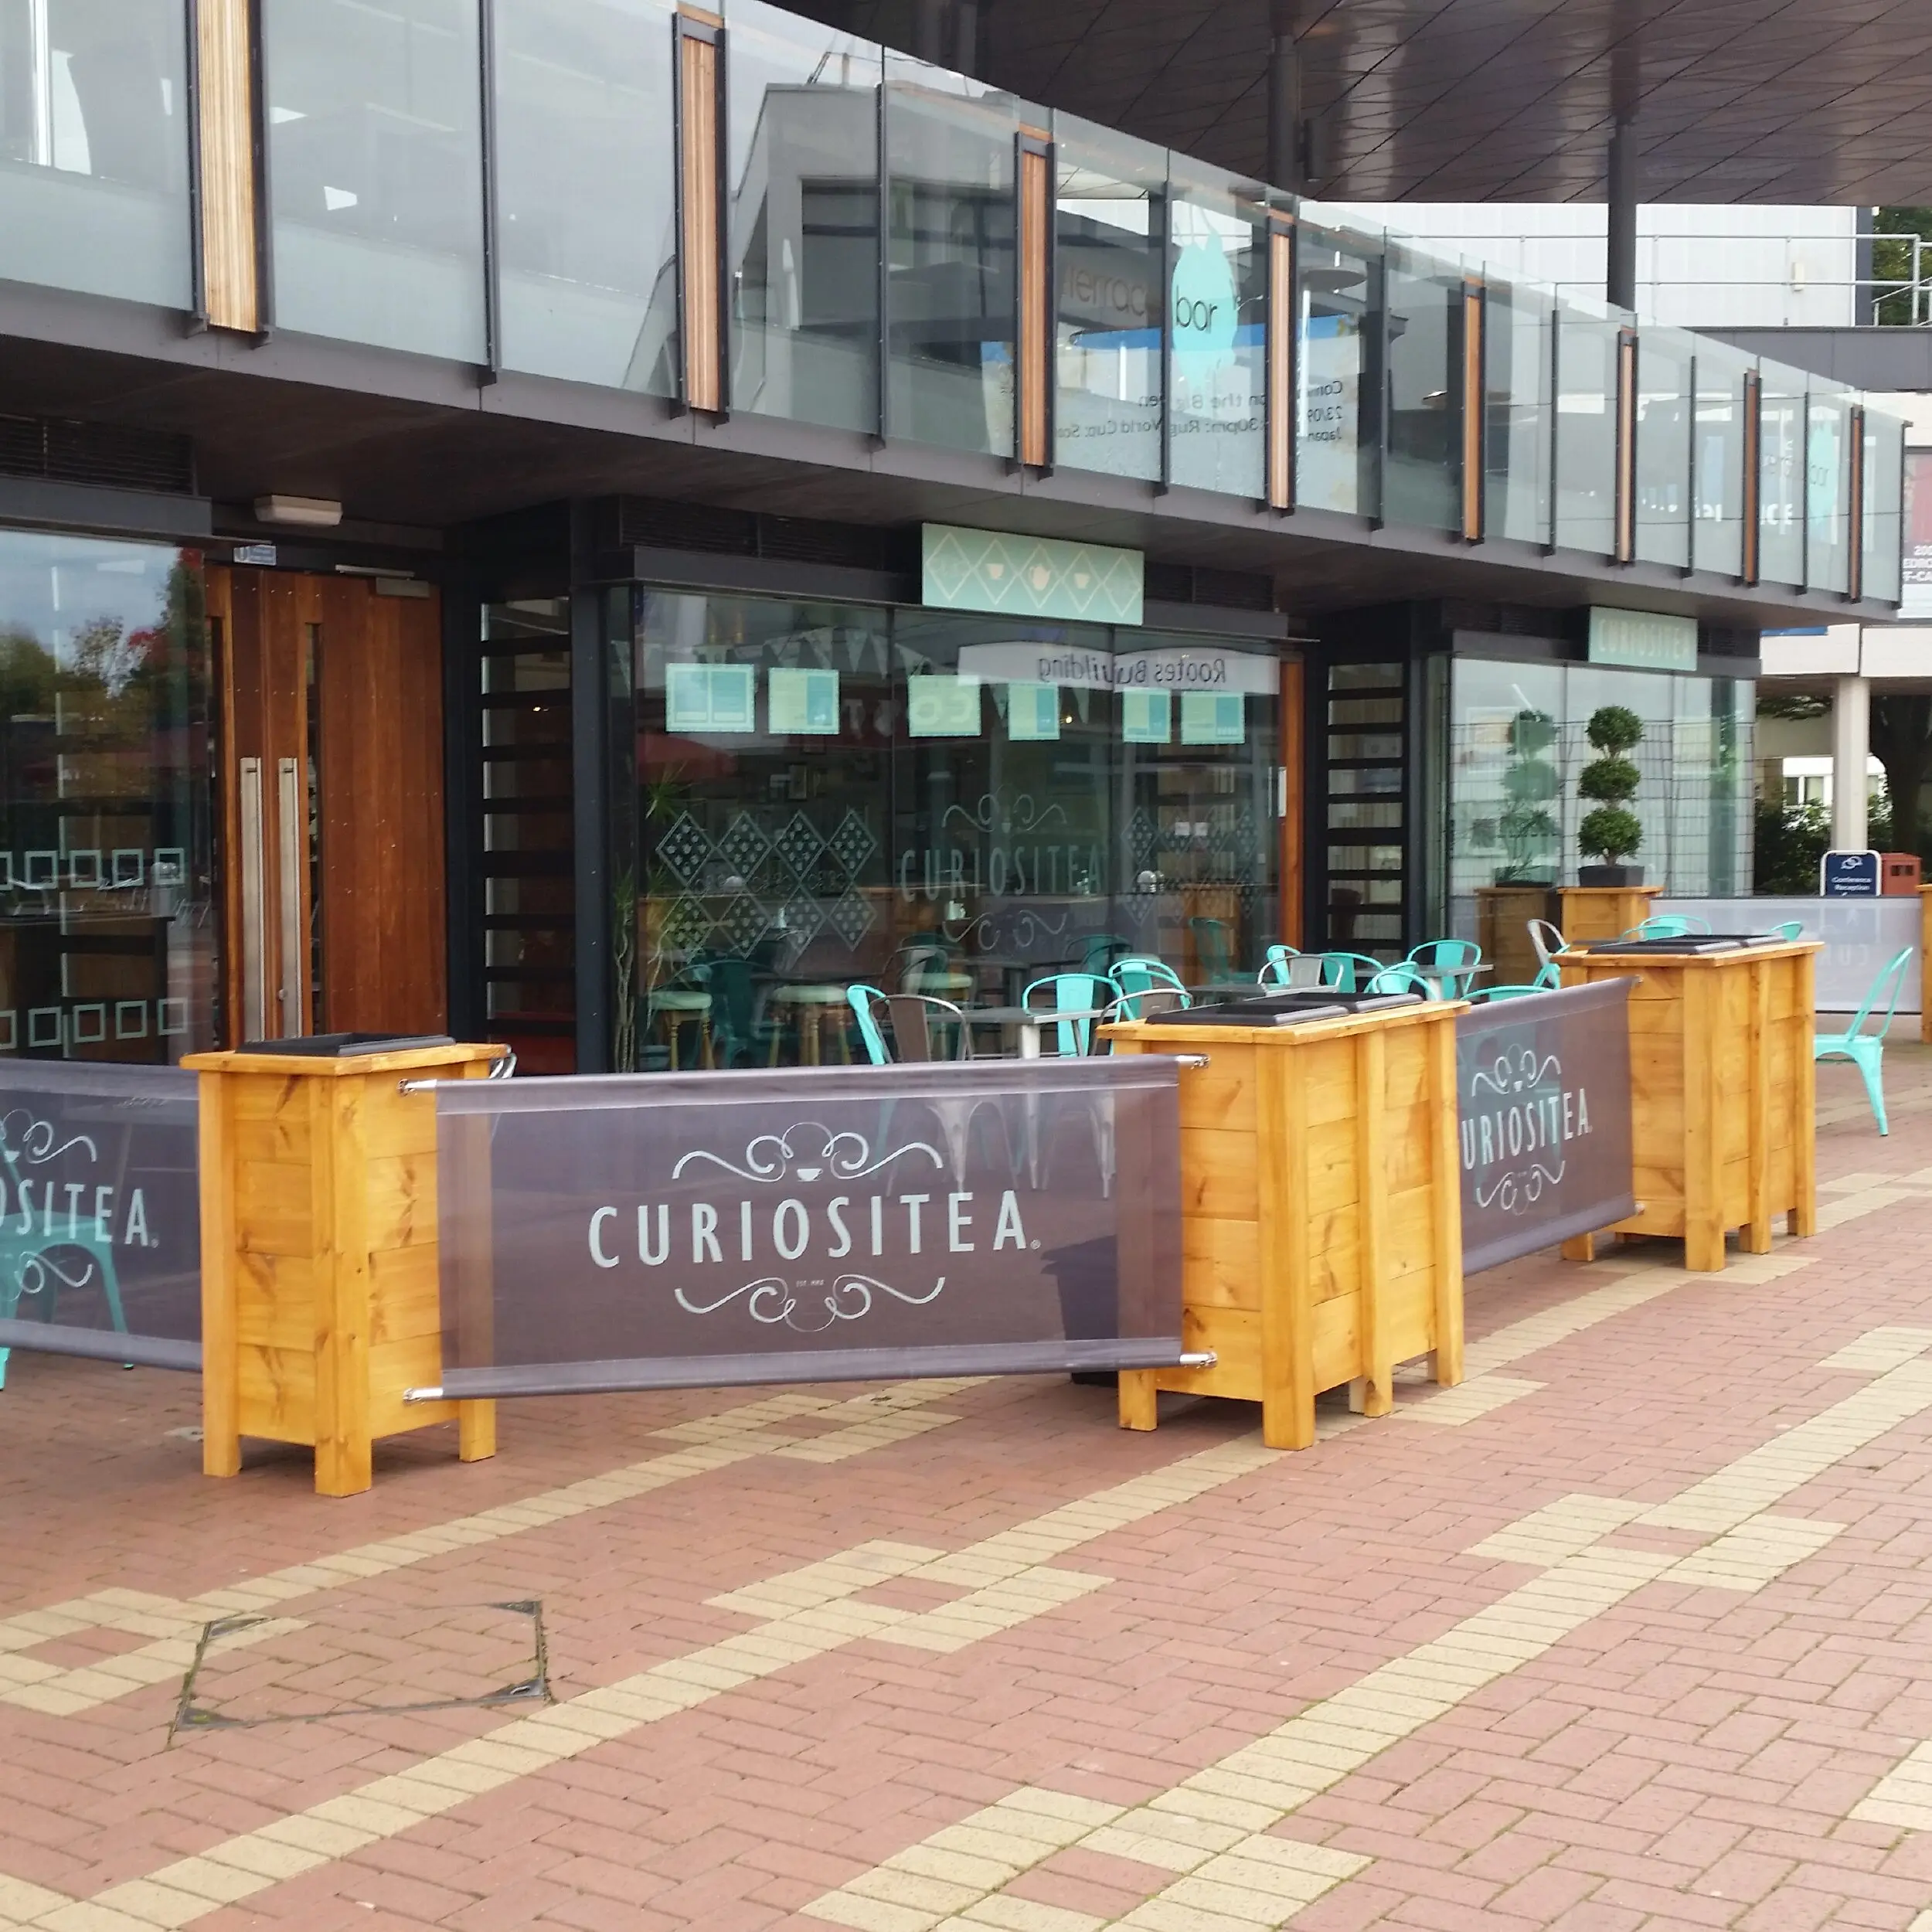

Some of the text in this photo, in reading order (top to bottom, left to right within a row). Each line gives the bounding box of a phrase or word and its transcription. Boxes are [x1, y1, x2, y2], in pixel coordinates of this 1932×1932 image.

[900, 844, 1102, 903] CURIOSITEA
[1461, 1088, 1590, 1170] URIOSITEA
[589, 1189, 1026, 1268] CURIOSITEA
